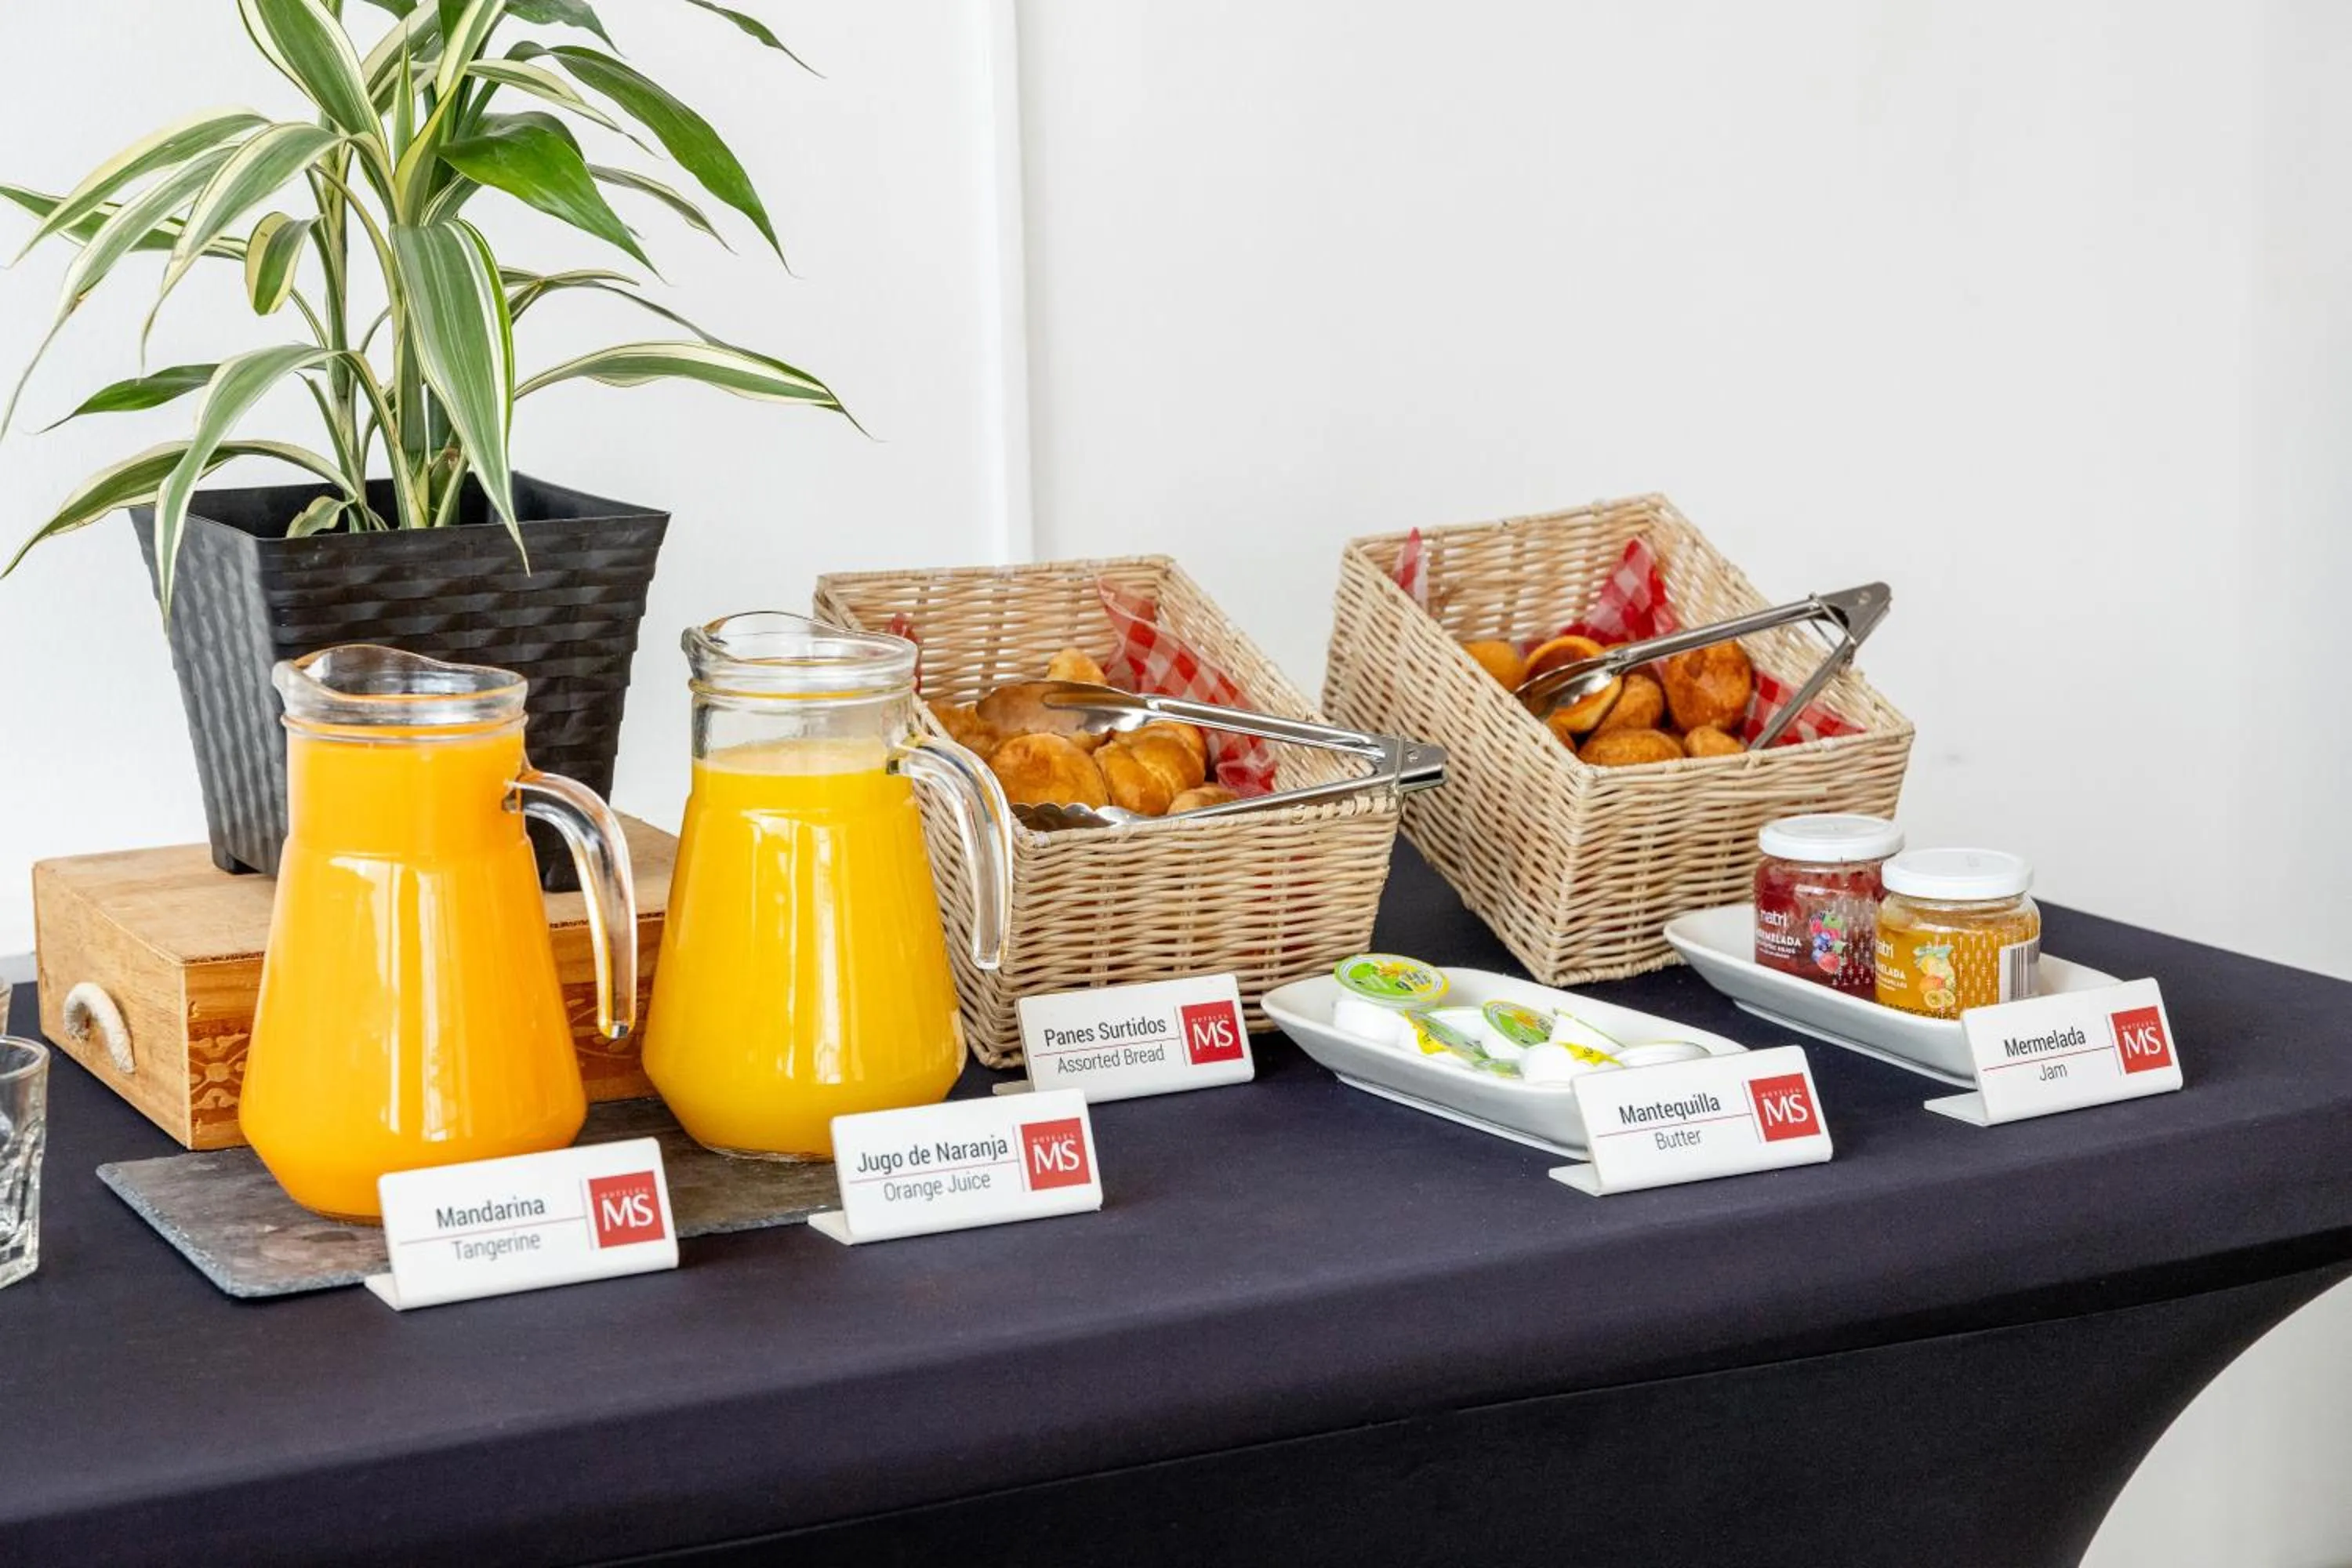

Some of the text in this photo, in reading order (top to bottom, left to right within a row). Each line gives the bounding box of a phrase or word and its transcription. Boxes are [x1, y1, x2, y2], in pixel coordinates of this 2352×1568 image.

[1044, 1017, 1167, 1047] Panes Surtidos
[1192, 1020, 1233, 1051] MS
[2004, 1026, 2086, 1057] Mermelada
[2122, 1025, 2161, 1060] MS
[1058, 1044, 1165, 1073] Assorted Bread
[2038, 1062, 2068, 1081] Jam
[1618, 1091, 1722, 1125] Mantequilla
[1762, 1094, 1808, 1127] MS
[857, 1134, 1008, 1175] Jugo de Naranja
[1654, 1129, 1702, 1150] Butter
[1033, 1139, 1080, 1175] MS
[884, 1171, 991, 1202] Orange Juice
[436, 1195, 546, 1229] Mandarina
[601, 1192, 654, 1232] MS
[452, 1232, 541, 1260] Tangerine
